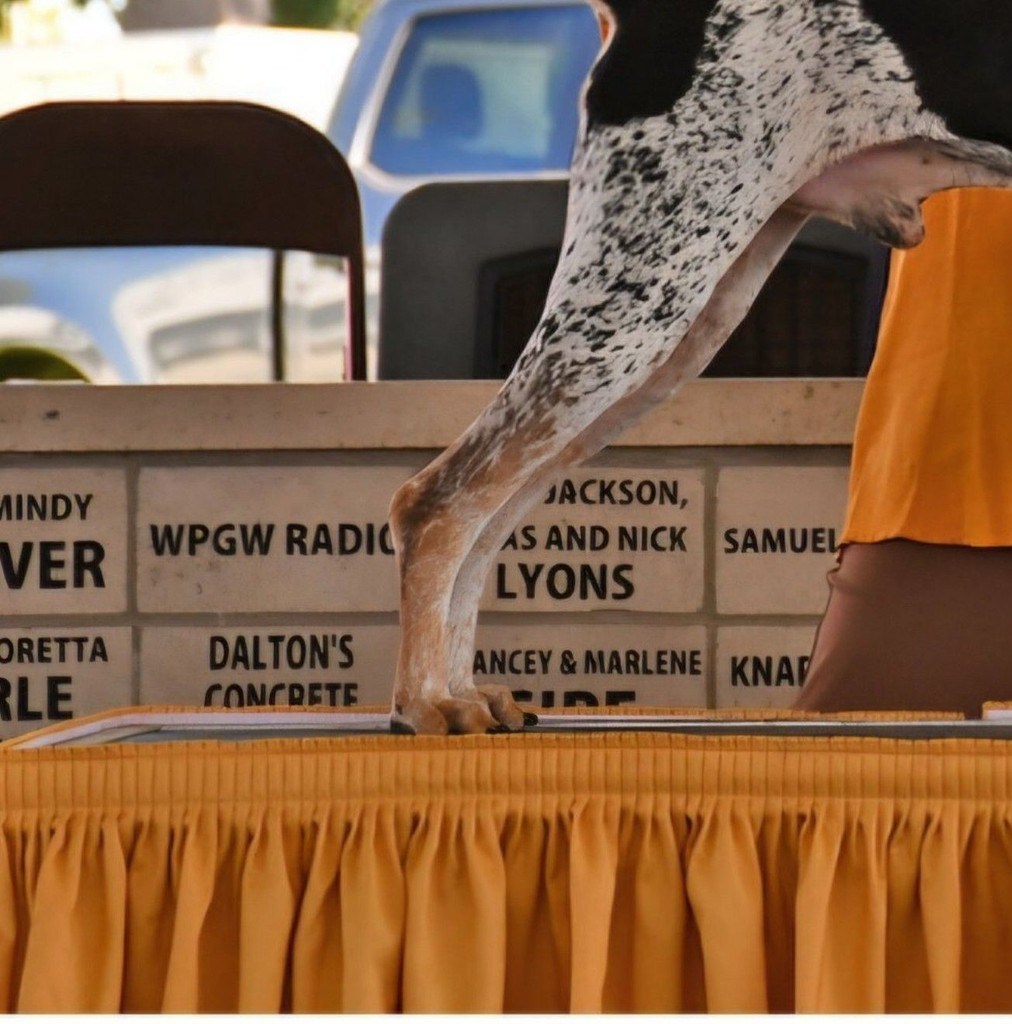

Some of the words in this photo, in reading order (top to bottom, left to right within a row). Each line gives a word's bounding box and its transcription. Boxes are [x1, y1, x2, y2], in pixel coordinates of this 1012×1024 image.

[150, 524, 274, 556] WPGW
[545, 525, 610, 552] AND
[618, 526, 688, 552] NICK
[724, 527, 838, 554] SAMUEL
[496, 562, 635, 601] LYONS
[209, 634, 355, 671] DALTON'S
[559, 649, 577, 675] &
[584, 649, 702, 676] MARLENE
